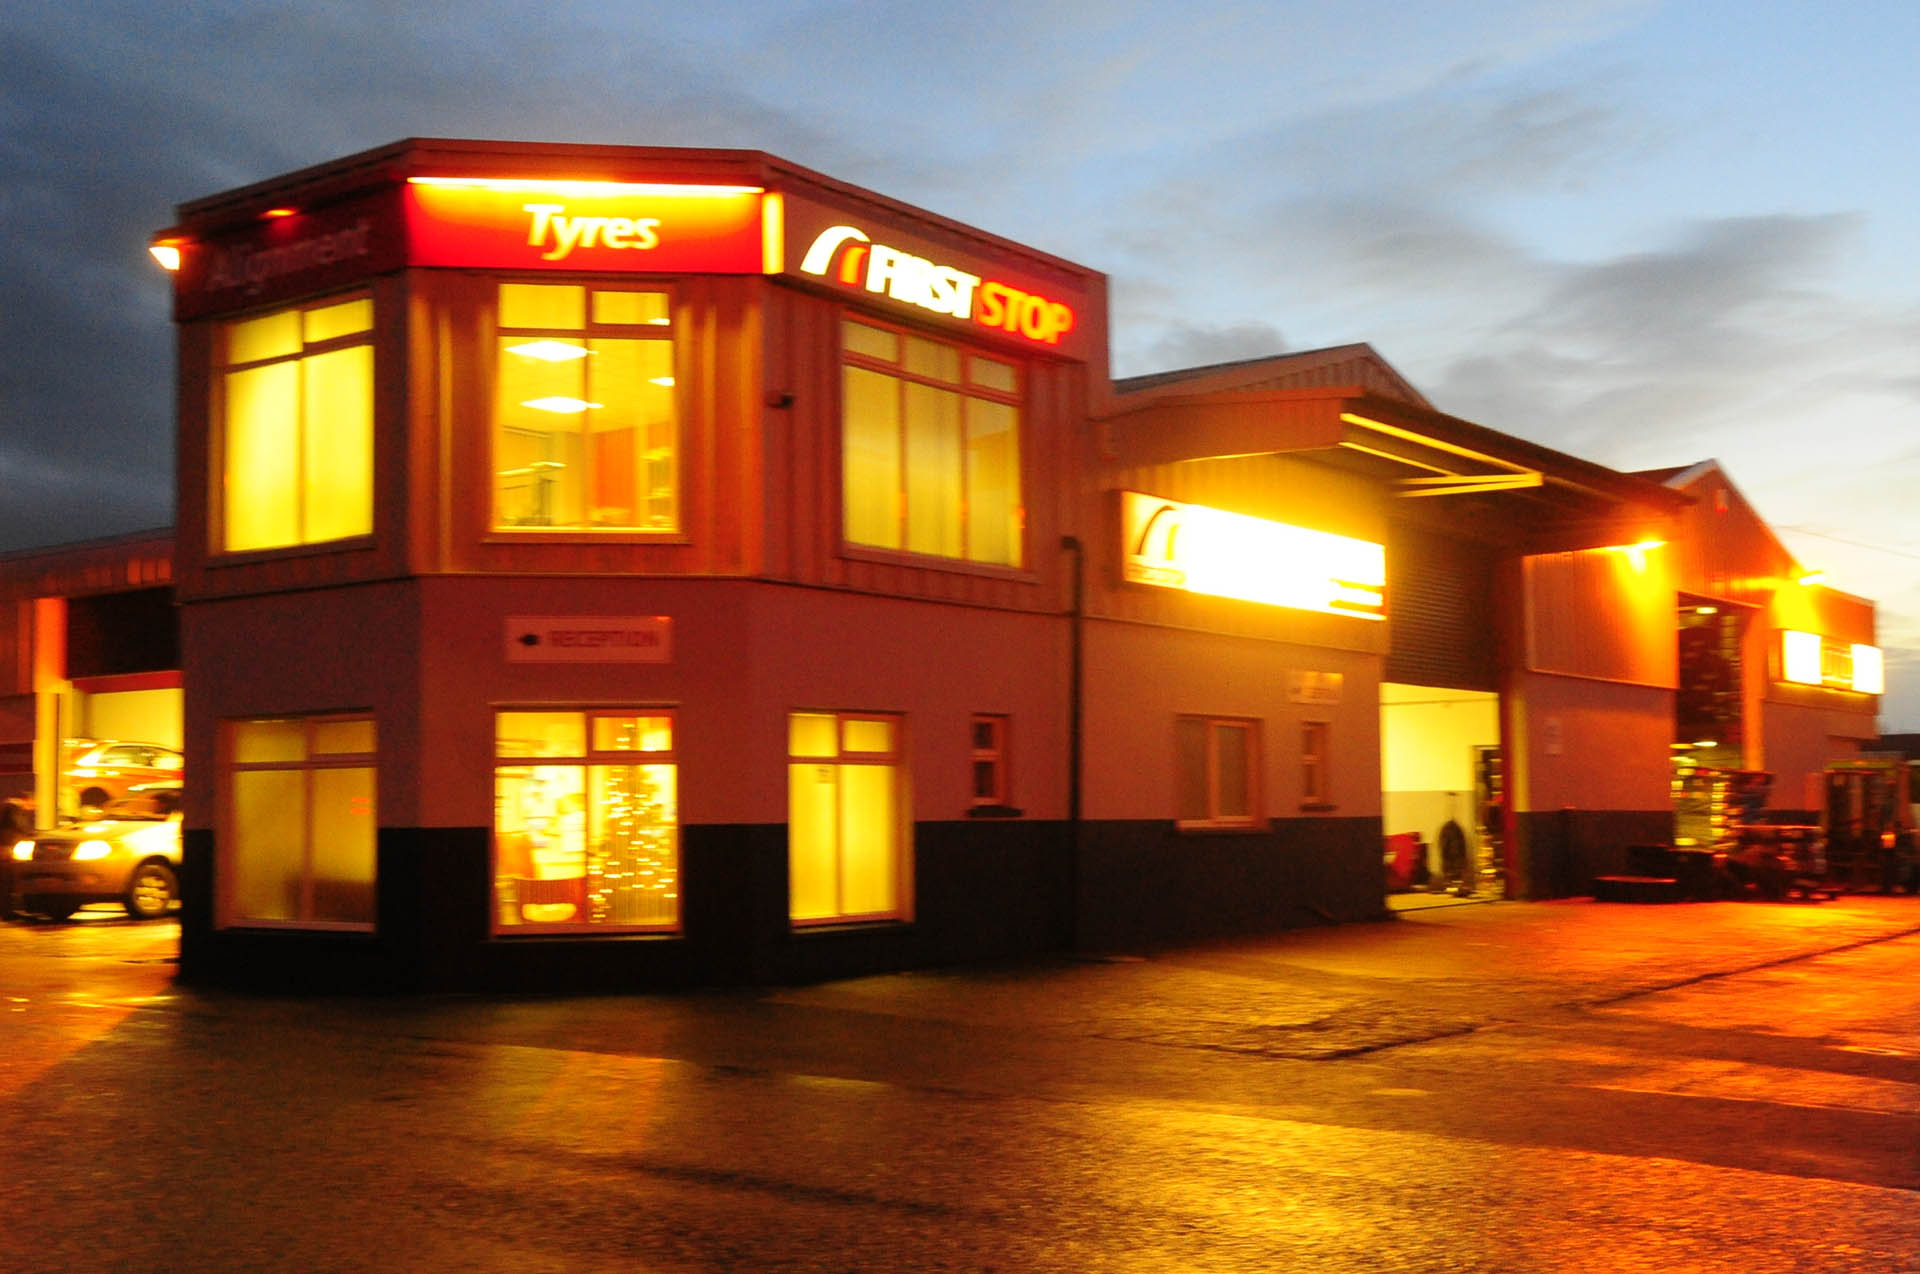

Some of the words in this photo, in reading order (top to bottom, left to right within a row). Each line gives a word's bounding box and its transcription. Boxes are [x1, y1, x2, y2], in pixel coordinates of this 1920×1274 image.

[522, 203, 662, 261] Tyres
[865, 244, 981, 319] FIRST
[975, 279, 1075, 345] STOP
